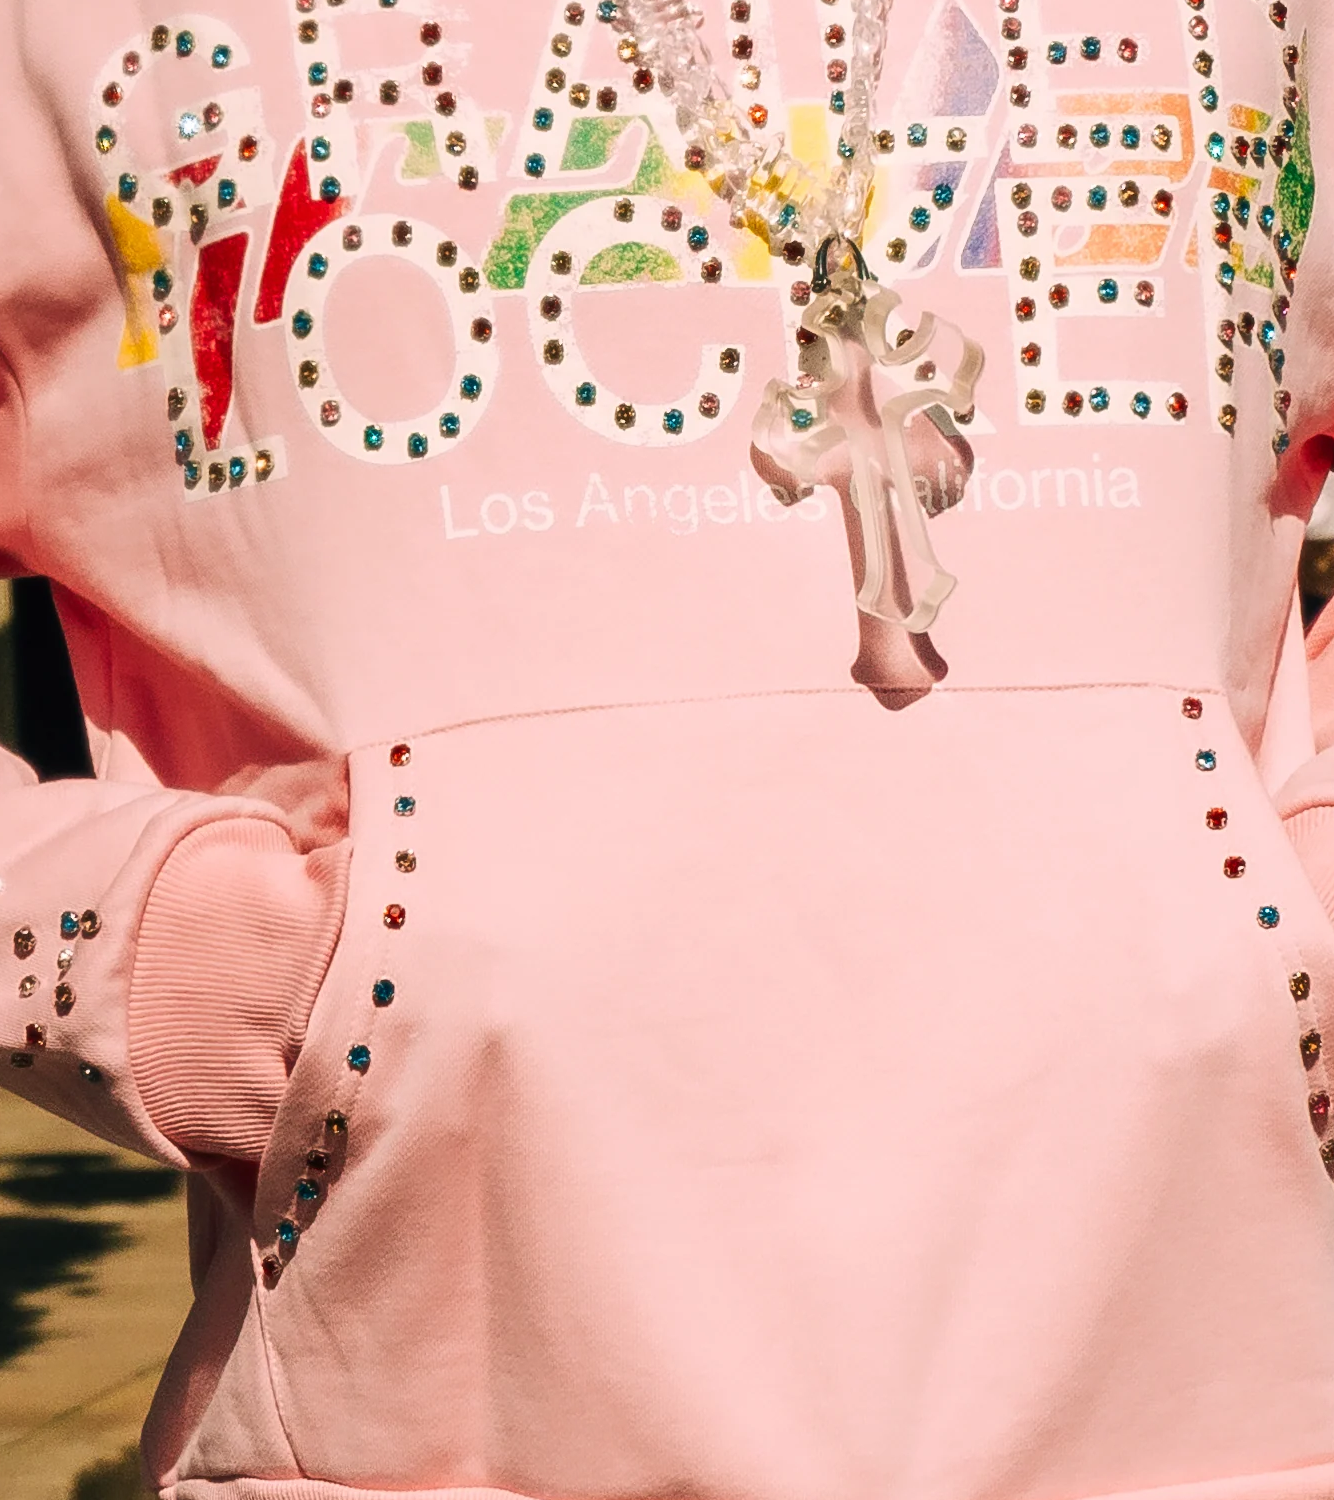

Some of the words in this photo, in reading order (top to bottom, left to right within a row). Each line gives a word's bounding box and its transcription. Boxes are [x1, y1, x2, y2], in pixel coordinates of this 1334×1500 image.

[162, 175, 1303, 503] LOCKER
[439, 484, 556, 540] Los
[575, 470, 829, 536] Angeles
